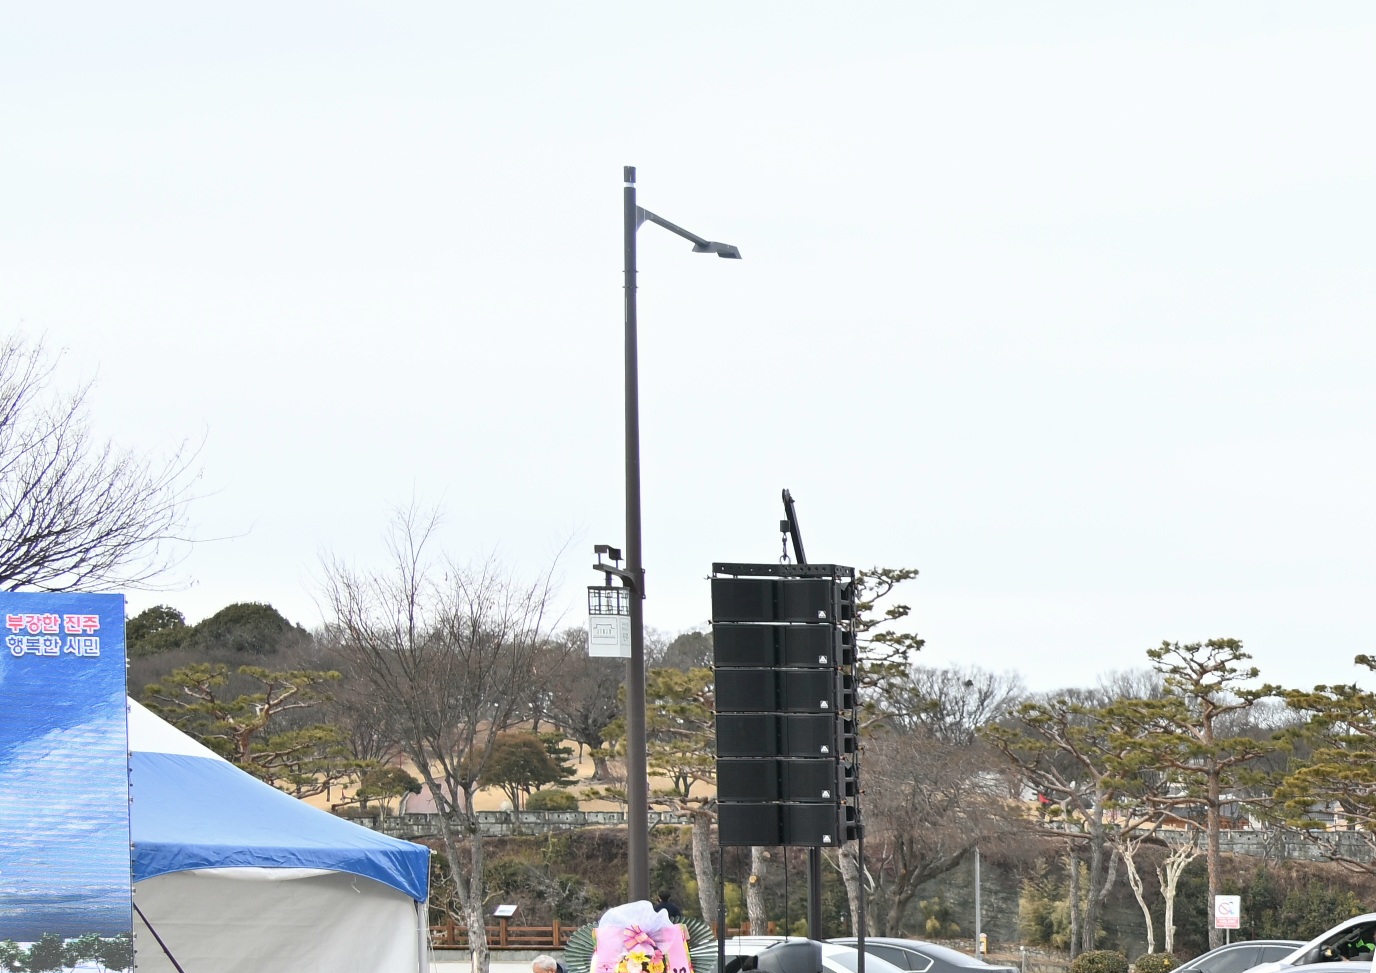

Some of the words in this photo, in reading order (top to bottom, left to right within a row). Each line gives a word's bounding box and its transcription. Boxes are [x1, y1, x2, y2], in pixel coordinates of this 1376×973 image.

[6, 613, 60, 633] 부강한
[64, 614, 99, 633] 진주
[6, 635, 60, 656] 행복한
[64, 637, 99, 656] 시민
